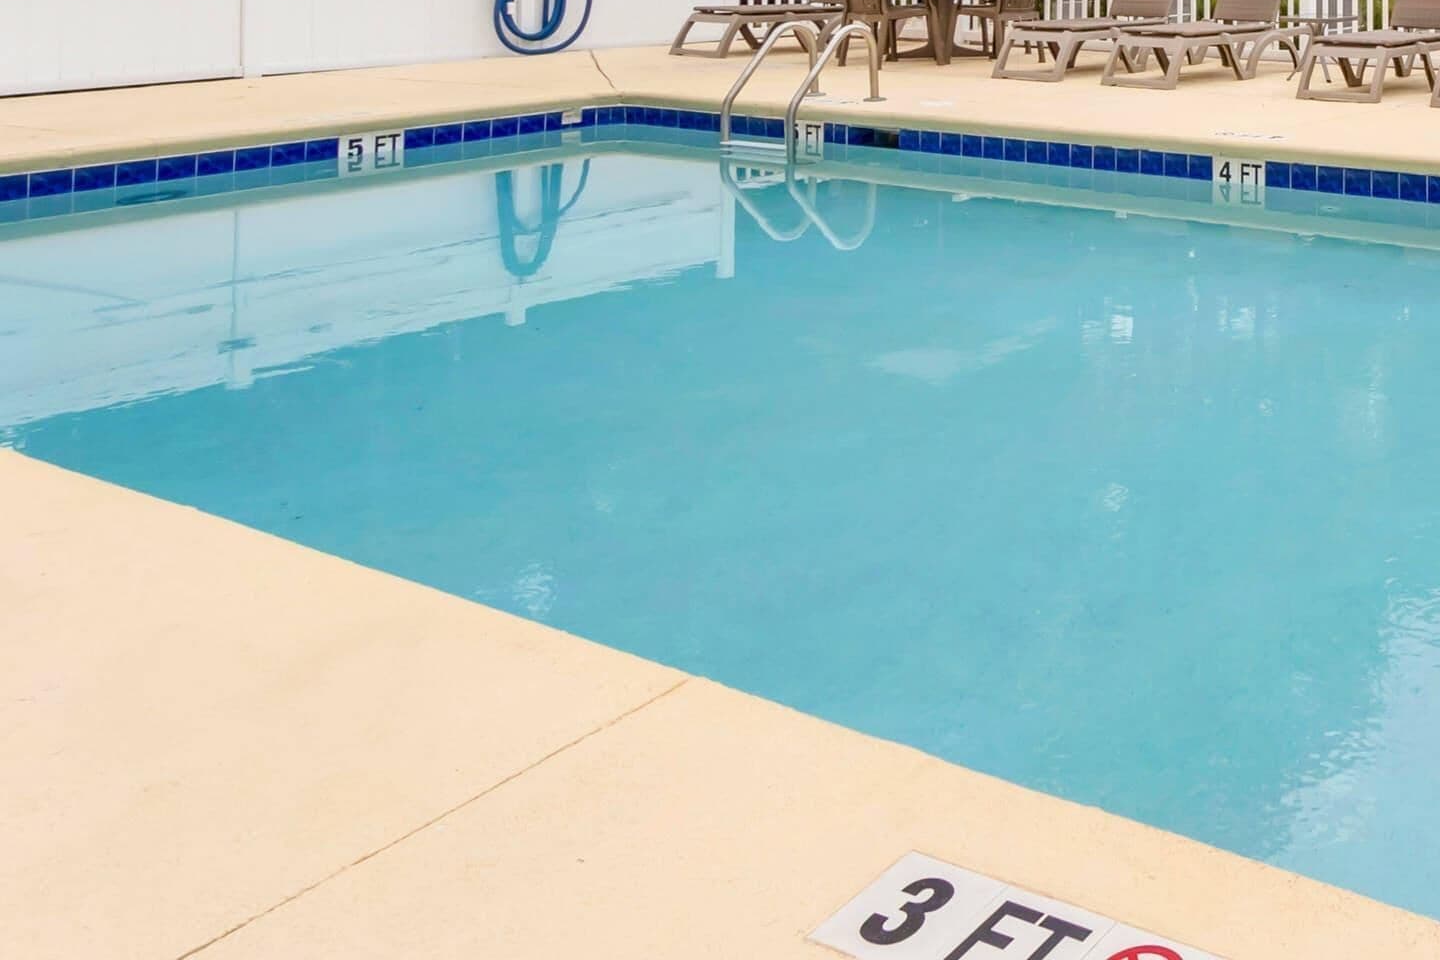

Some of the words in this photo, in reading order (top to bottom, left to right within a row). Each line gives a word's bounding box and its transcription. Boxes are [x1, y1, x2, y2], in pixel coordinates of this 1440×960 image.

[806, 124, 821, 141] FT
[348, 138, 363, 157] 5
[375, 133, 401, 155] FT
[1219, 161, 1232, 183] 4
[1240, 163, 1262, 185] FT
[859, 877, 955, 945] 3
[943, 900, 1093, 960] FT
